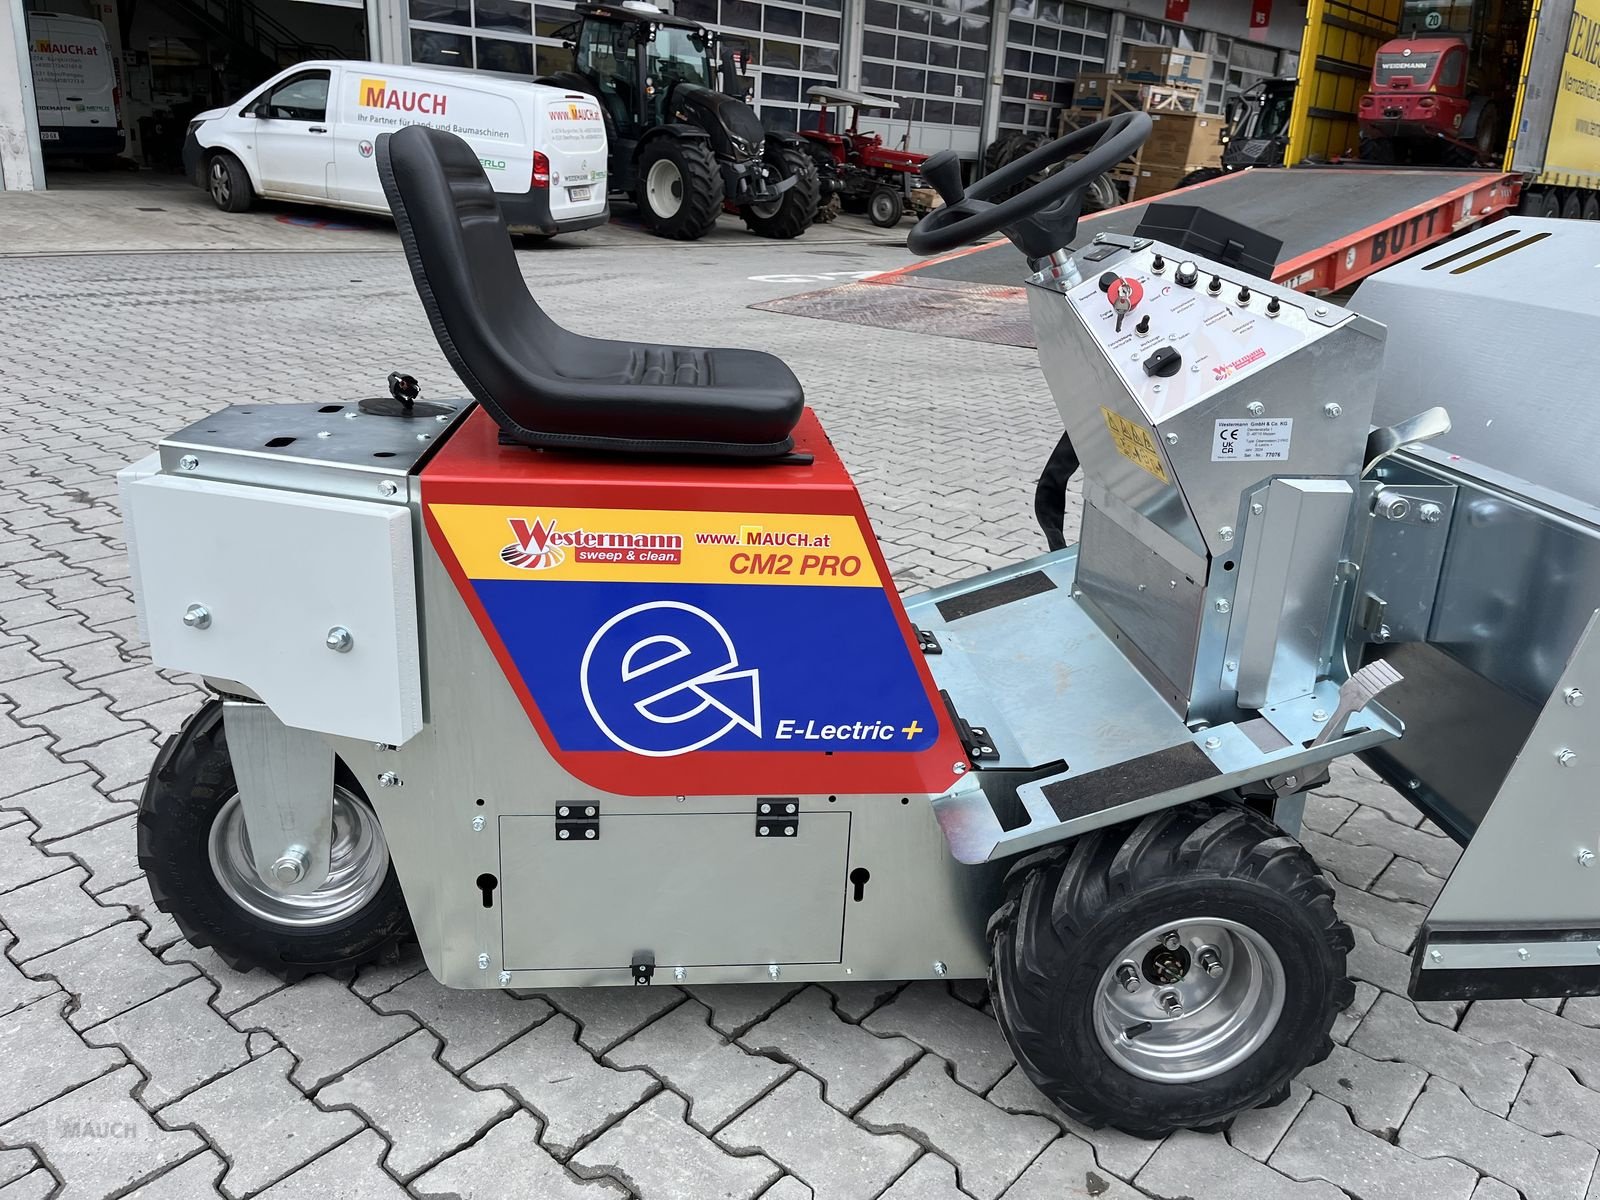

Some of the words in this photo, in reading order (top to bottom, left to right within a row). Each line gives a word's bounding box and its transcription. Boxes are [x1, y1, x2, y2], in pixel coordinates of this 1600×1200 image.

[1429, 14, 1440, 26] 20
[1382, 62, 1427, 70] WEIDEMANN
[366, 87, 447, 116] MAUCH
[357, 113, 369, 122] Ihr
[370, 115, 397, 126] Partner
[399, 118, 411, 127] für
[435, 124, 451, 132] und
[453, 125, 510, 139] Baumaschinen
[480, 158, 507, 169] ERLO
[1371, 207, 1440, 265] BUTT
[508, 519, 682, 552] Westermann
[579, 550, 623, 563] sweep
[626, 550, 636, 561] &
[640, 550, 678, 562] clean.
[729, 553, 793, 575] CM2
[800, 554, 862, 577] PRO
[775, 719, 895, 740] E-Lectric
